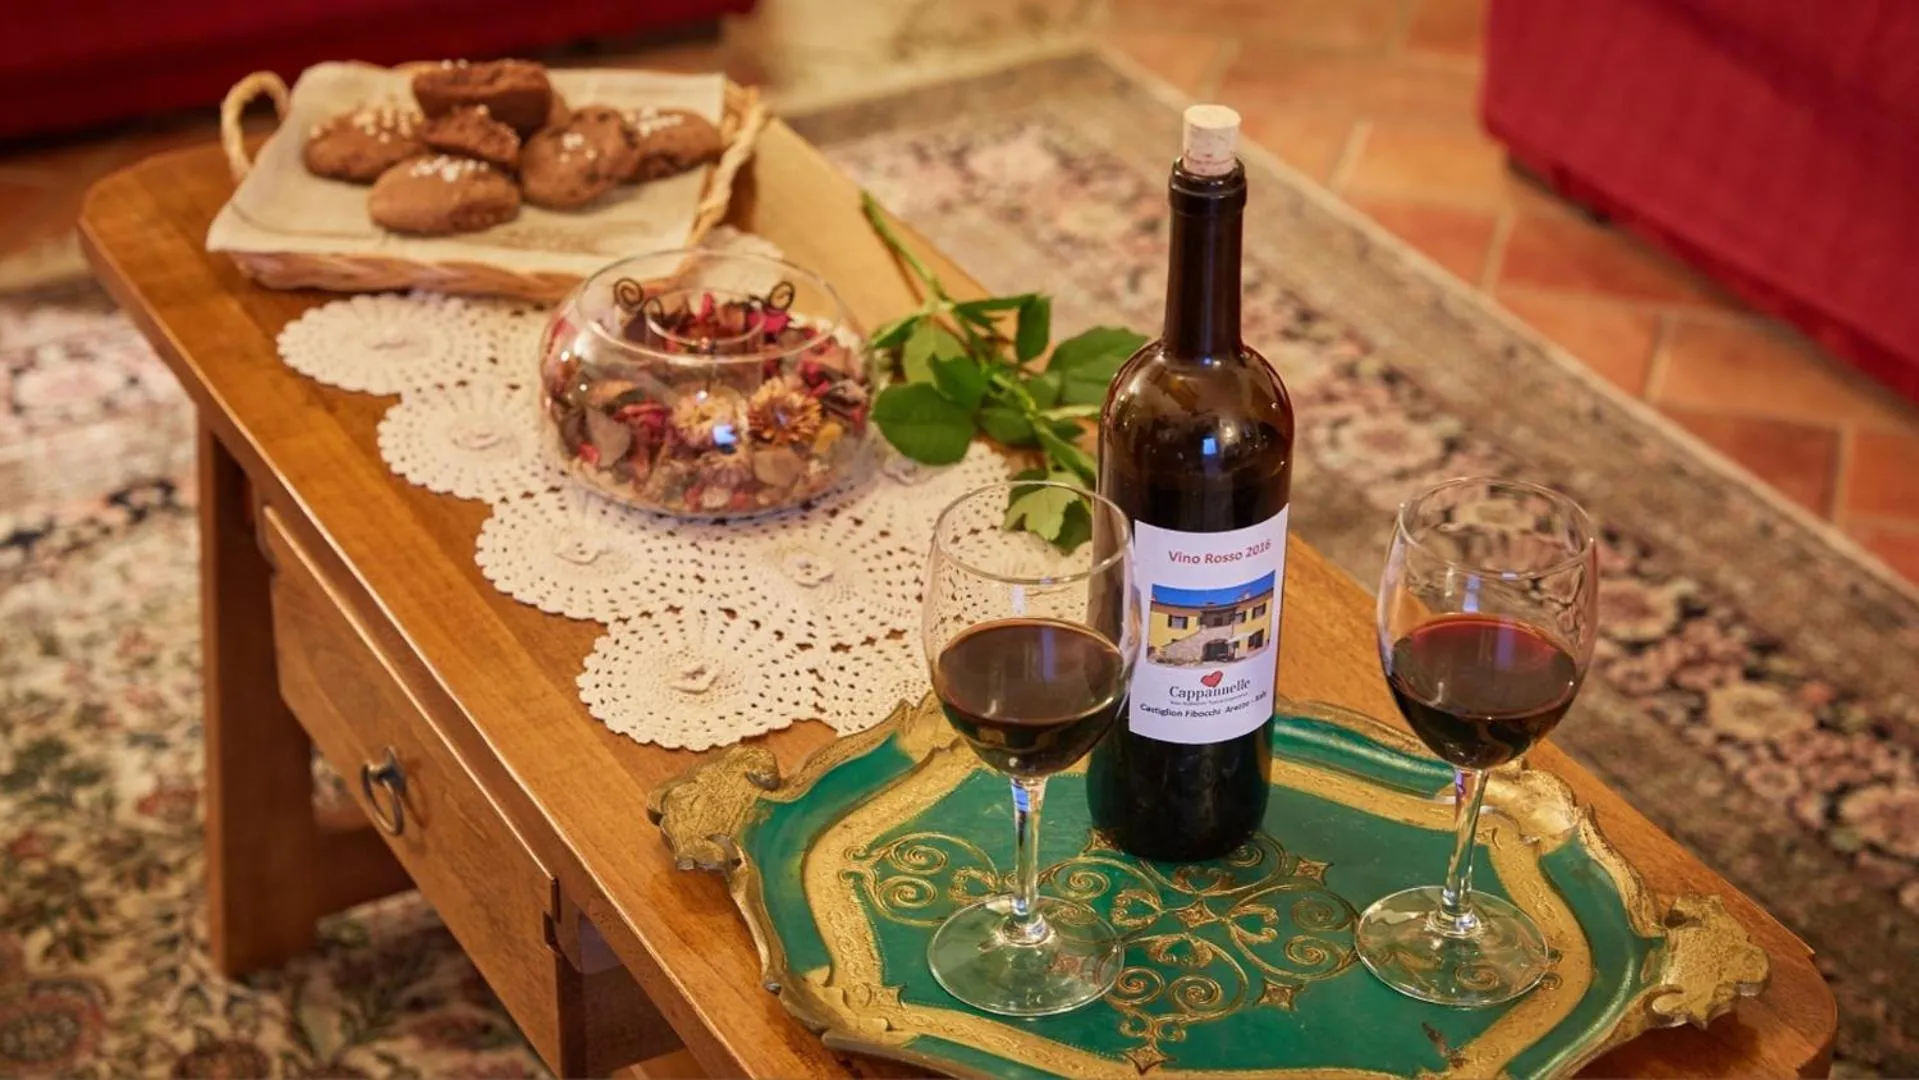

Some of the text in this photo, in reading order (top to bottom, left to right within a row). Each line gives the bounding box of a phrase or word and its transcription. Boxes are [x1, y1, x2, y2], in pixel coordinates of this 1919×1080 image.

[1168, 539, 1272, 564] Vino Rosso 2016
[1169, 678, 1251, 701] Cappannelle
[1139, 702, 1183, 717] Castiglion
[1184, 708, 1221, 718] Fibocchi
